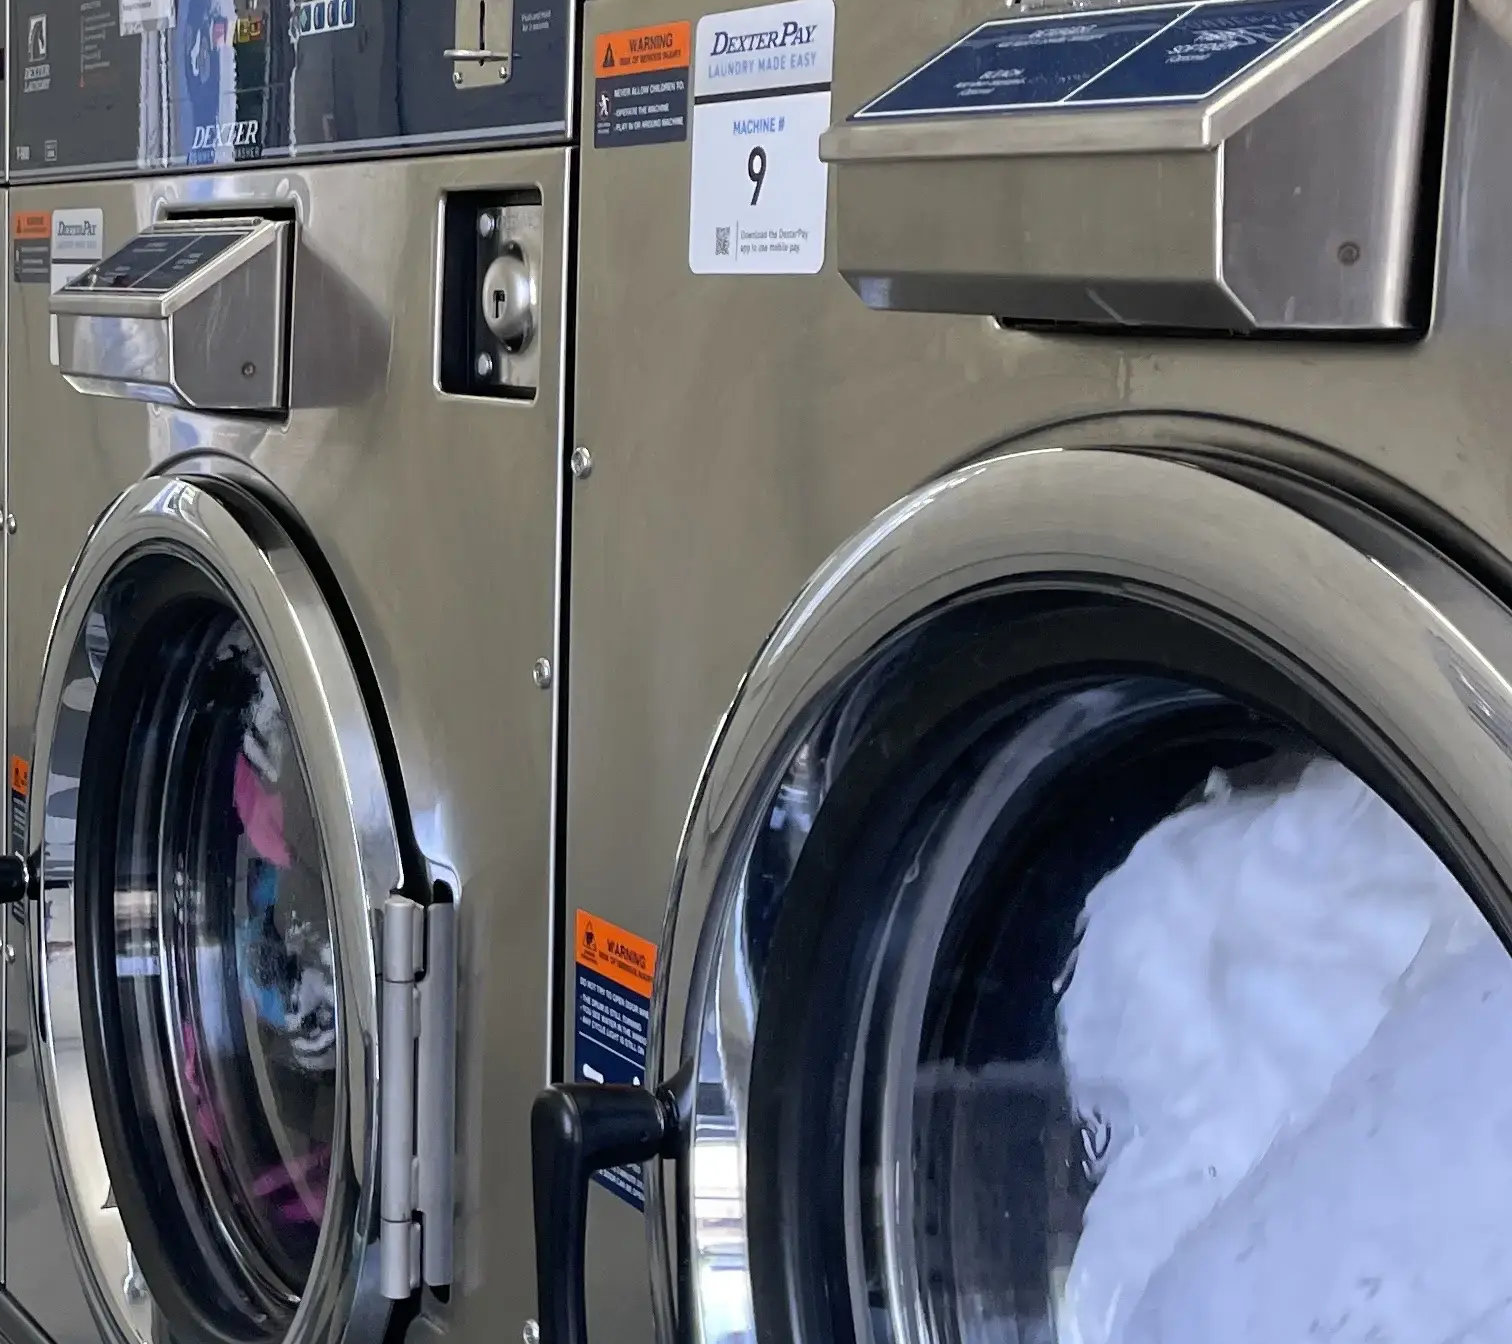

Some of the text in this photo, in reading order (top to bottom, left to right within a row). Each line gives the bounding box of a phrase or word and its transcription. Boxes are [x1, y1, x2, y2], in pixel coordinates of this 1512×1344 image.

[628, 32, 673, 53] WARNING
[708, 52, 817, 79] LAUNDRY MADE EASY
[631, 84, 650, 96] ALLOW
[650, 81, 676, 94] CHILDREN
[192, 119, 259, 149] DEXTER
[733, 116, 785, 136] MACHINE #
[747, 145, 767, 206] 9
[740, 229, 767, 240] Download
[768, 228, 777, 239] the
[740, 243, 750, 255] app
[751, 243, 758, 252] to
[758, 243, 768, 253] use
[769, 241, 788, 252] mobile
[606, 939, 647, 970] WARNING
